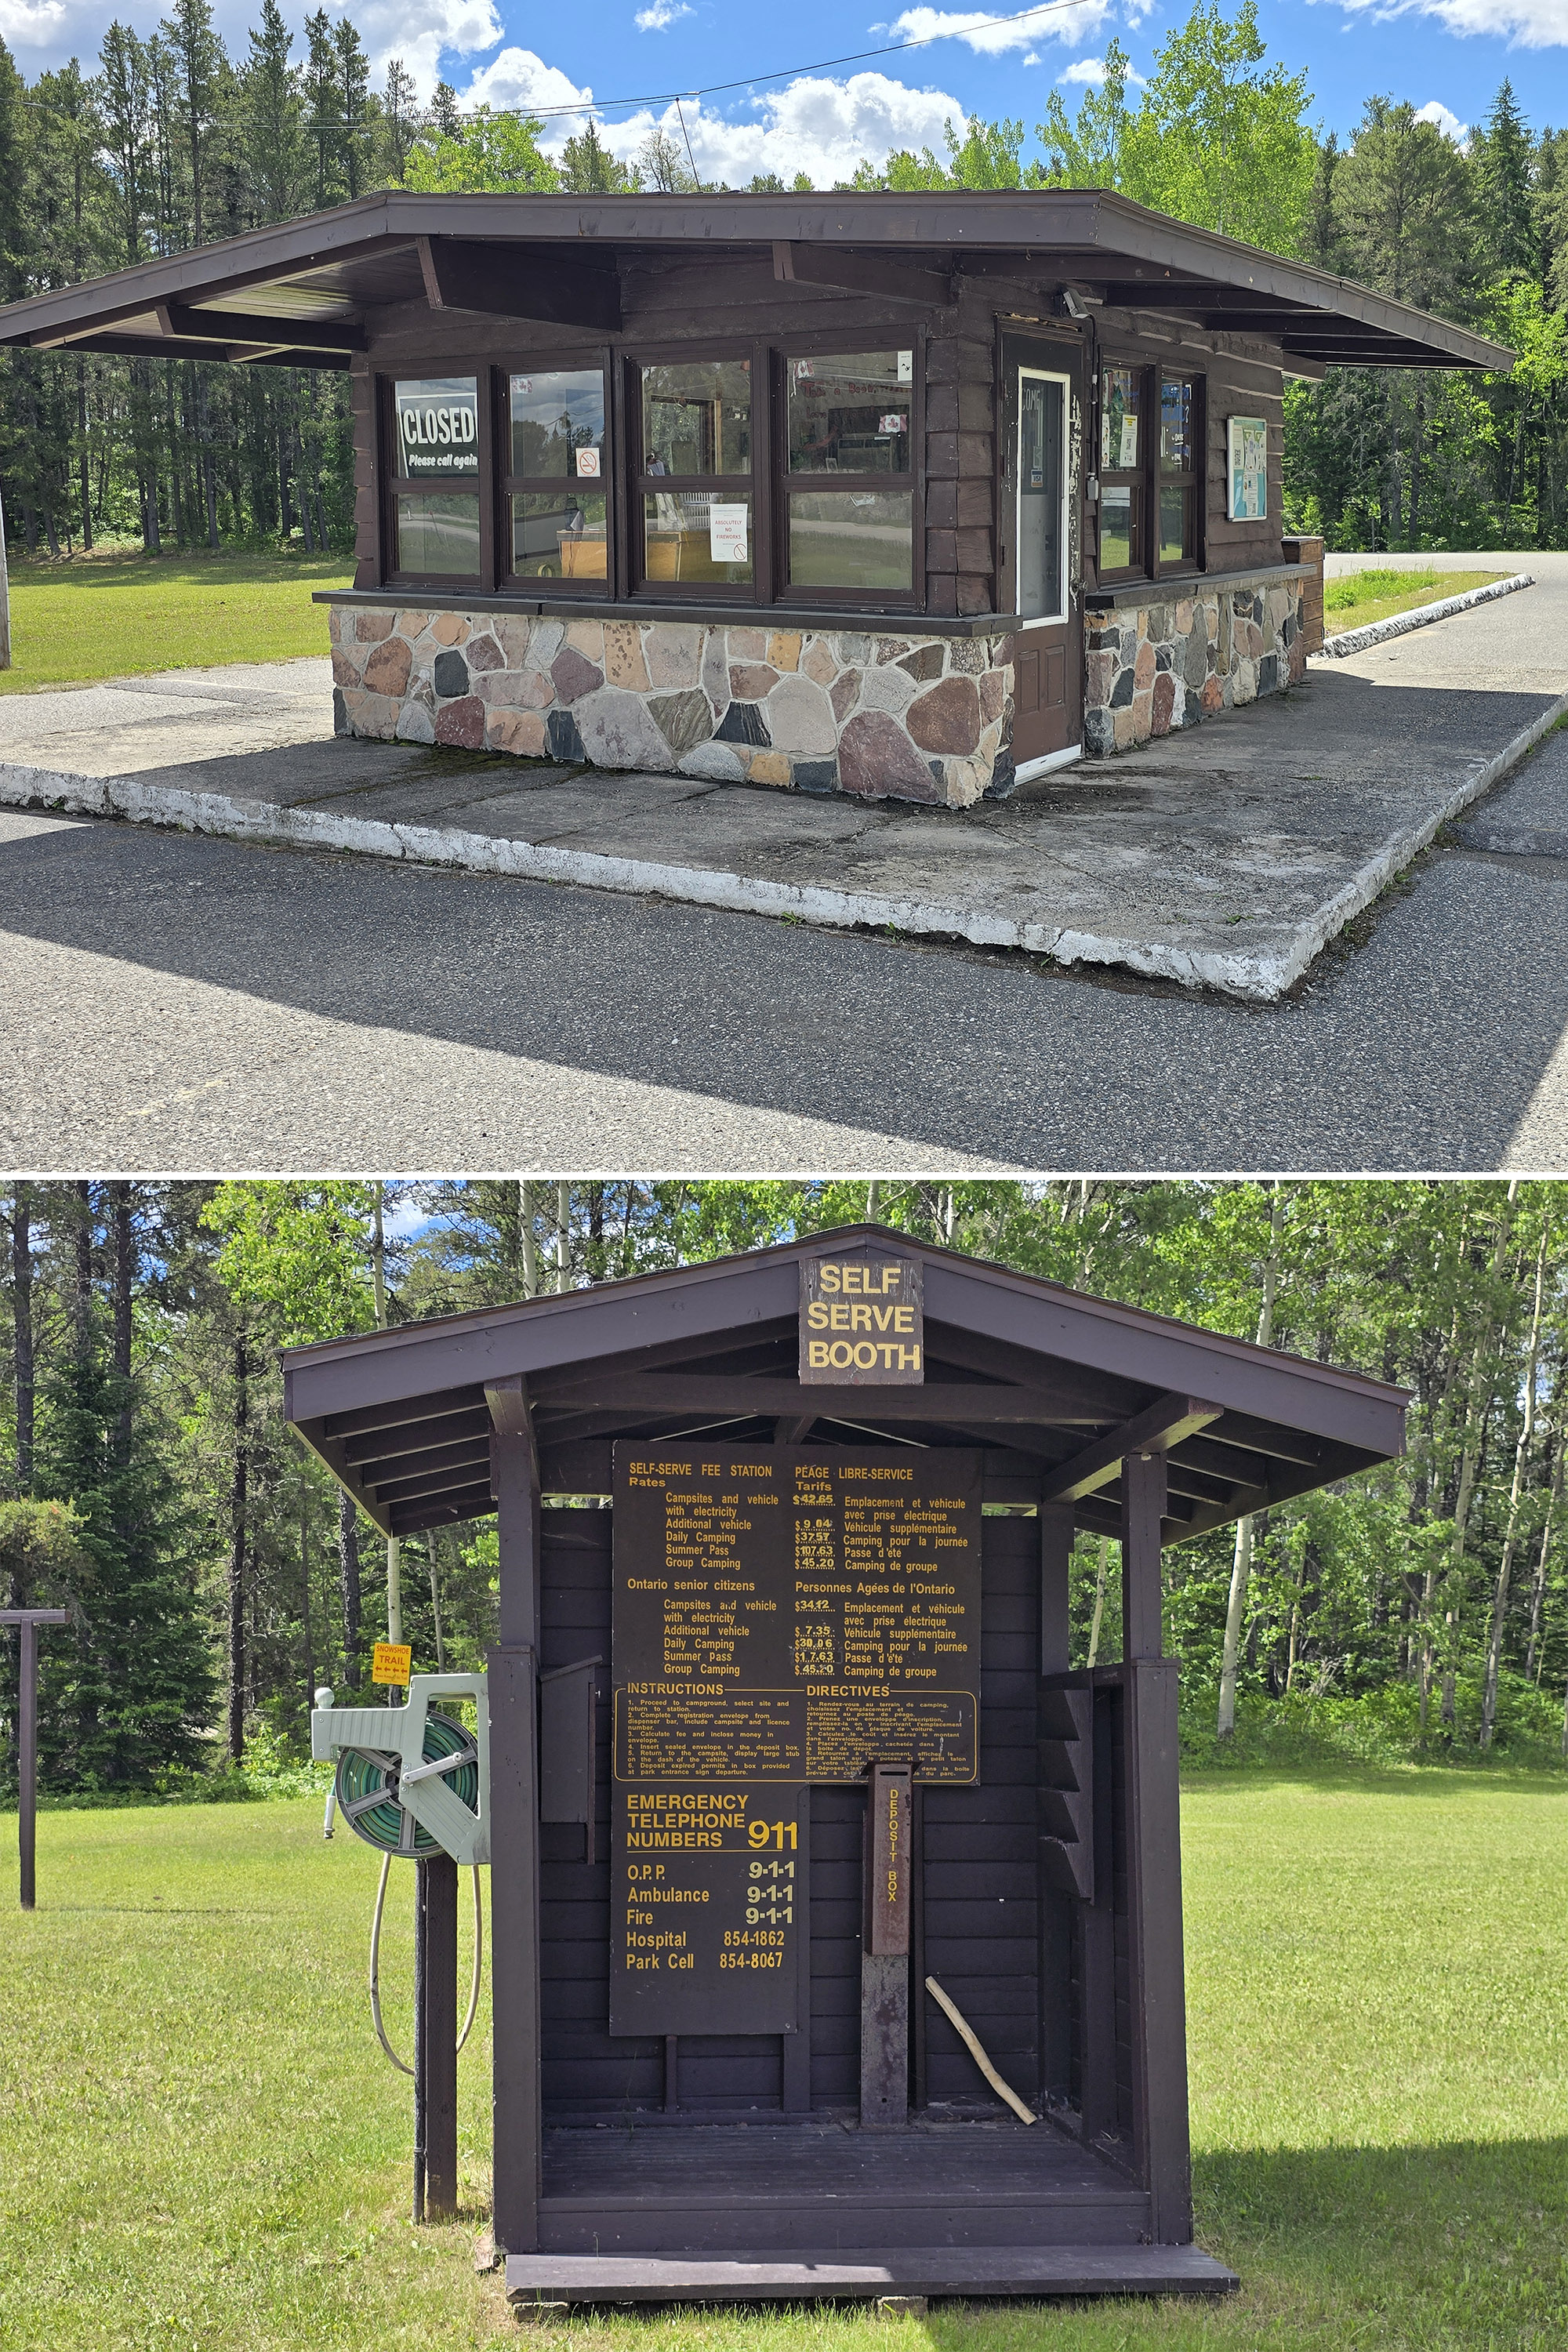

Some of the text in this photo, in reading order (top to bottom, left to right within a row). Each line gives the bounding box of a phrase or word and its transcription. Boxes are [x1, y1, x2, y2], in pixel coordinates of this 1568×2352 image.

[403, 407, 475, 445] CLOSED
[408, 453, 477, 470] Please call again
[820, 1265, 901, 1294] SELF
[808, 1302, 914, 1333] SERVE
[808, 1341, 920, 1370] BOOTH
[630, 1463, 772, 1476] SELF-SERVE FEE STATION
[839, 1467, 913, 1480] LIBRE-SERVICE
[630, 1478, 666, 1486] Rates
[796, 1482, 832, 1490] Tarifs
[666, 1492, 779, 1504] Campsites and vehicle
[844, 1497, 965, 1508] Emplacement et véhicule
[666, 1505, 737, 1519] with electricity
[874, 1511, 895, 1521] prise
[904, 1511, 947, 1523] électrique
[666, 1519, 751, 1530] Additional vehicle
[844, 1522, 956, 1535] Véhicule supplémentaire
[666, 1531, 735, 1544] Daily Camping
[844, 1535, 968, 1548] Camping pour la journée
[666, 1544, 728, 1555] Summer Pass
[844, 1548, 871, 1557] Passe
[666, 1557, 741, 1570] Group Camping
[845, 1559, 938, 1573] Camping de groupe
[628, 1578, 755, 1591] Ontario senior citizens
[796, 1581, 852, 1592] Personnes
[893, 1583, 905, 1593] de
[910, 1584, 955, 1594] l'Ontario
[664, 1599, 710, 1612] Campsites
[746, 1601, 776, 1610] vehicle
[844, 1602, 965, 1614] Emplacement et véhicule
[664, 1613, 735, 1625] with electricity
[844, 1616, 946, 1628] avec prise électrique
[664, 1625, 750, 1635] Additional vehicle
[844, 1628, 956, 1640] Véhicule supplémentaire
[376, 1646, 409, 1654] SNOWSHOE
[664, 1638, 735, 1651] Daily Camping
[844, 1641, 967, 1653] Camping pour la journée
[379, 1655, 405, 1665] TRAIL
[664, 1651, 731, 1661] Summer Pass
[845, 1653, 871, 1663] Passe
[664, 1664, 739, 1676] Group Camping
[844, 1665, 937, 1679] Camping de groupe
[628, 1683, 724, 1695] INSTRUCTIONS
[807, 1686, 890, 1697] DIRECTIVES
[627, 1795, 749, 1809] EMERGENCY
[628, 1813, 797, 1849] TELEPHONE 911
[627, 1832, 721, 1846] NUMBERS
[888, 1790, 898, 1902] DEPOSIT BOX
[628, 1888, 710, 1903] Ambulance
[627, 1910, 653, 1925] Fire
[627, 1931, 785, 1950] Hospital 854-1862
[627, 1952, 782, 1969] Park Cell 854-8067
